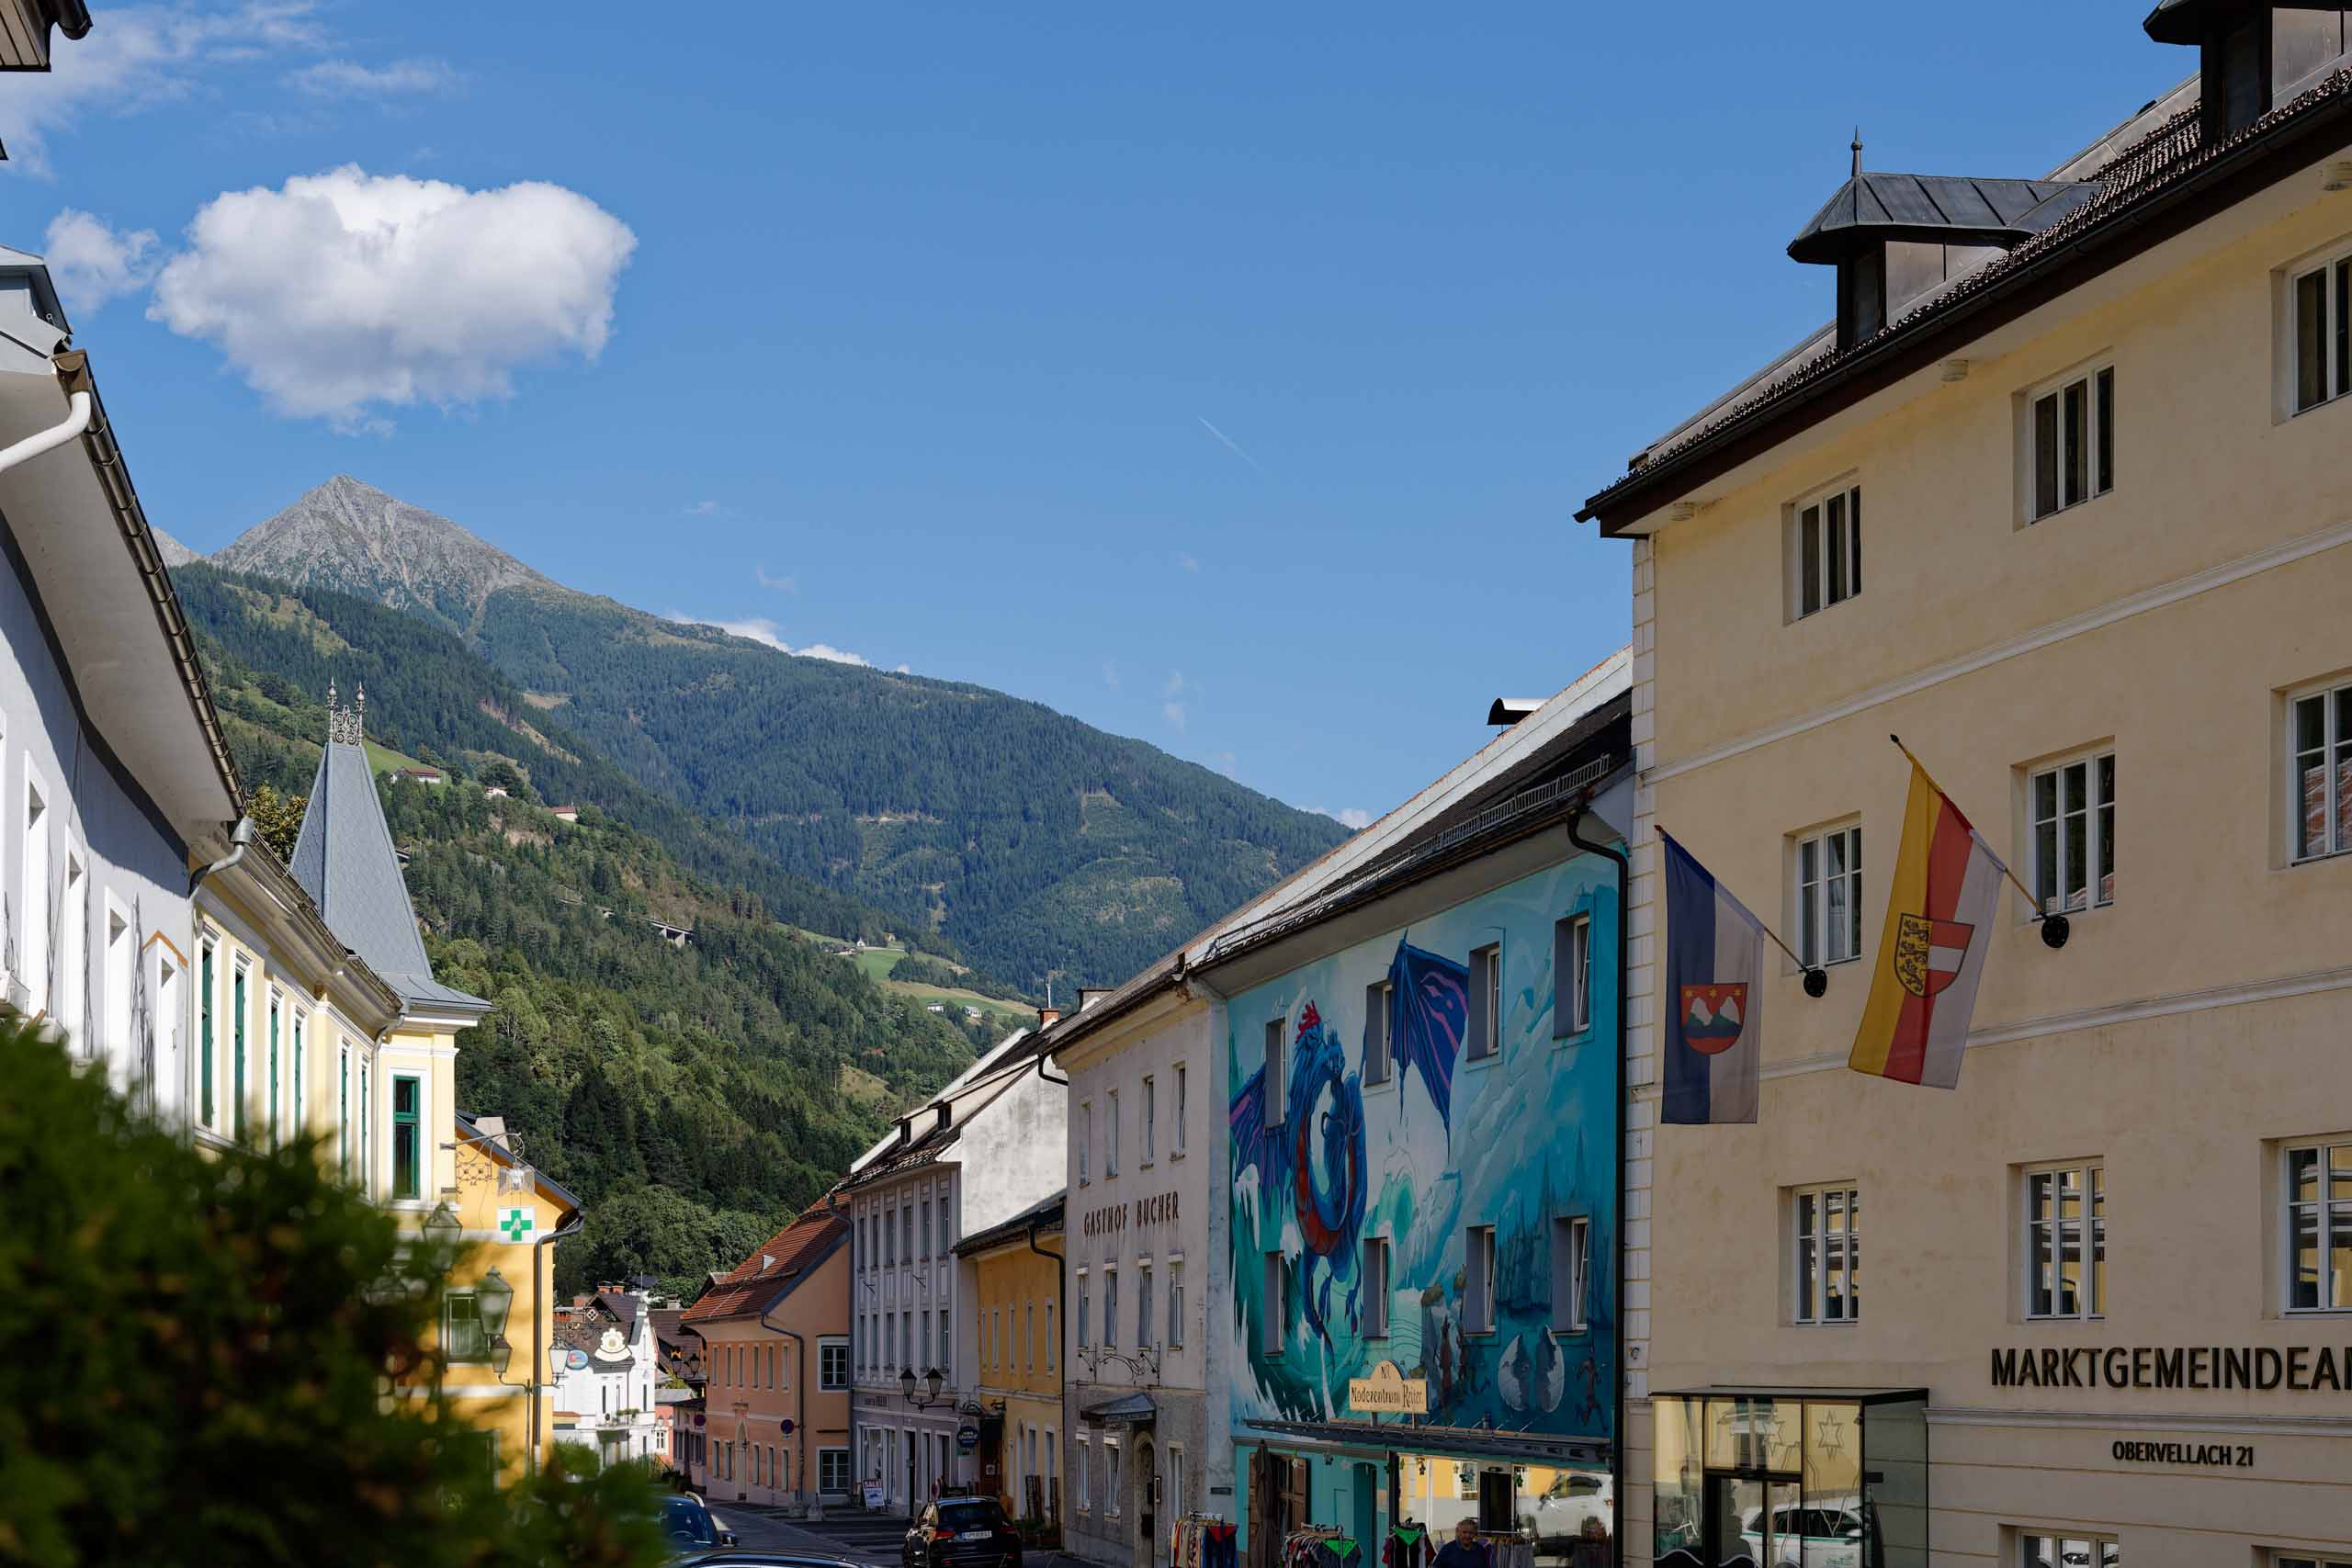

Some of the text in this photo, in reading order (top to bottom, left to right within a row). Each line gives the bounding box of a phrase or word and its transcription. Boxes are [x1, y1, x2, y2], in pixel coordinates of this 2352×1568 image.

[1084, 1191, 1180, 1237] GASTHOF BUCHER
[1991, 1348, 2352, 1391] MARKTGEMEINDEA
[2112, 1441, 2254, 1467] OBERVELLACH 21
